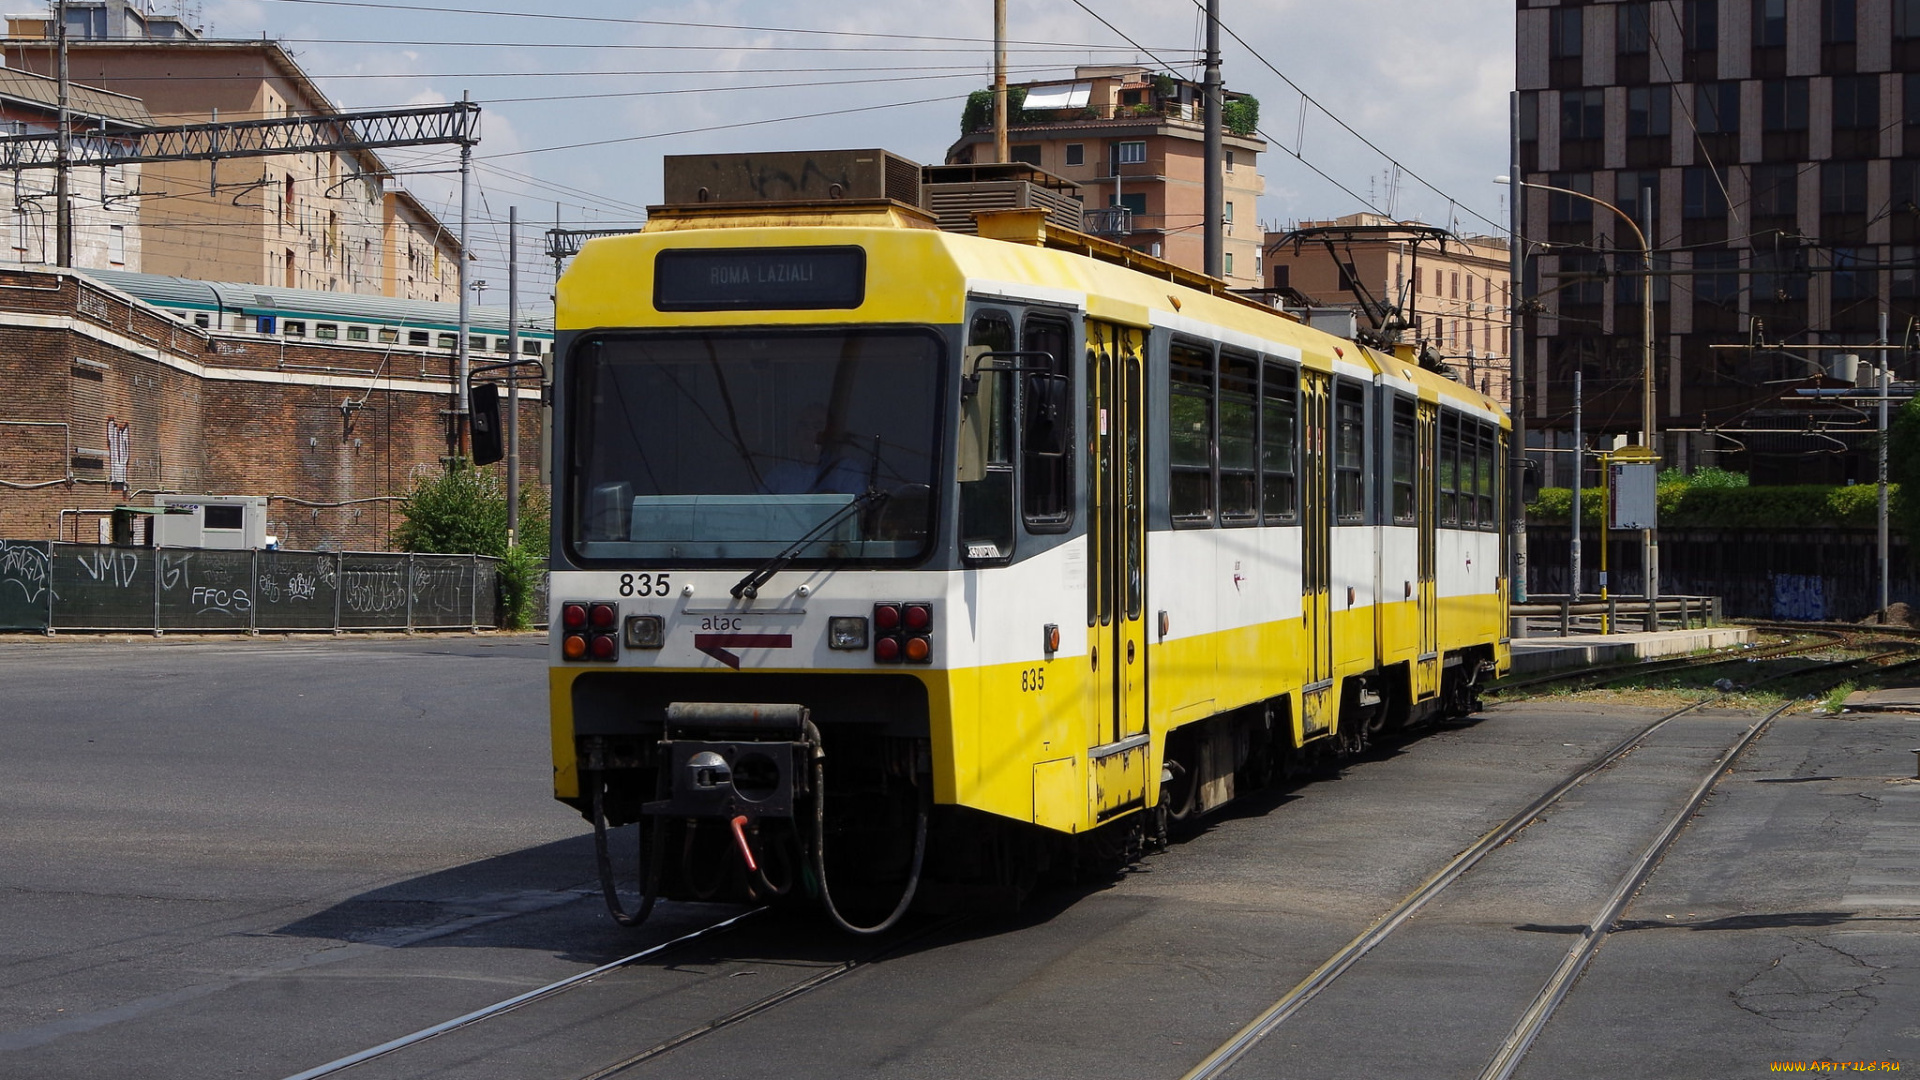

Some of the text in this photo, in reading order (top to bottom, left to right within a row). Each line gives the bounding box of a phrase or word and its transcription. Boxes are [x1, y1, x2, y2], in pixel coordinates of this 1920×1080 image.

[710, 262, 814, 285] ROMA LAZIALI
[77, 549, 138, 588] VMD
[618, 573, 671, 597] 835
[191, 586, 252, 611] FFCS
[700, 615, 742, 632] atac
[1021, 667, 1045, 693] 835
